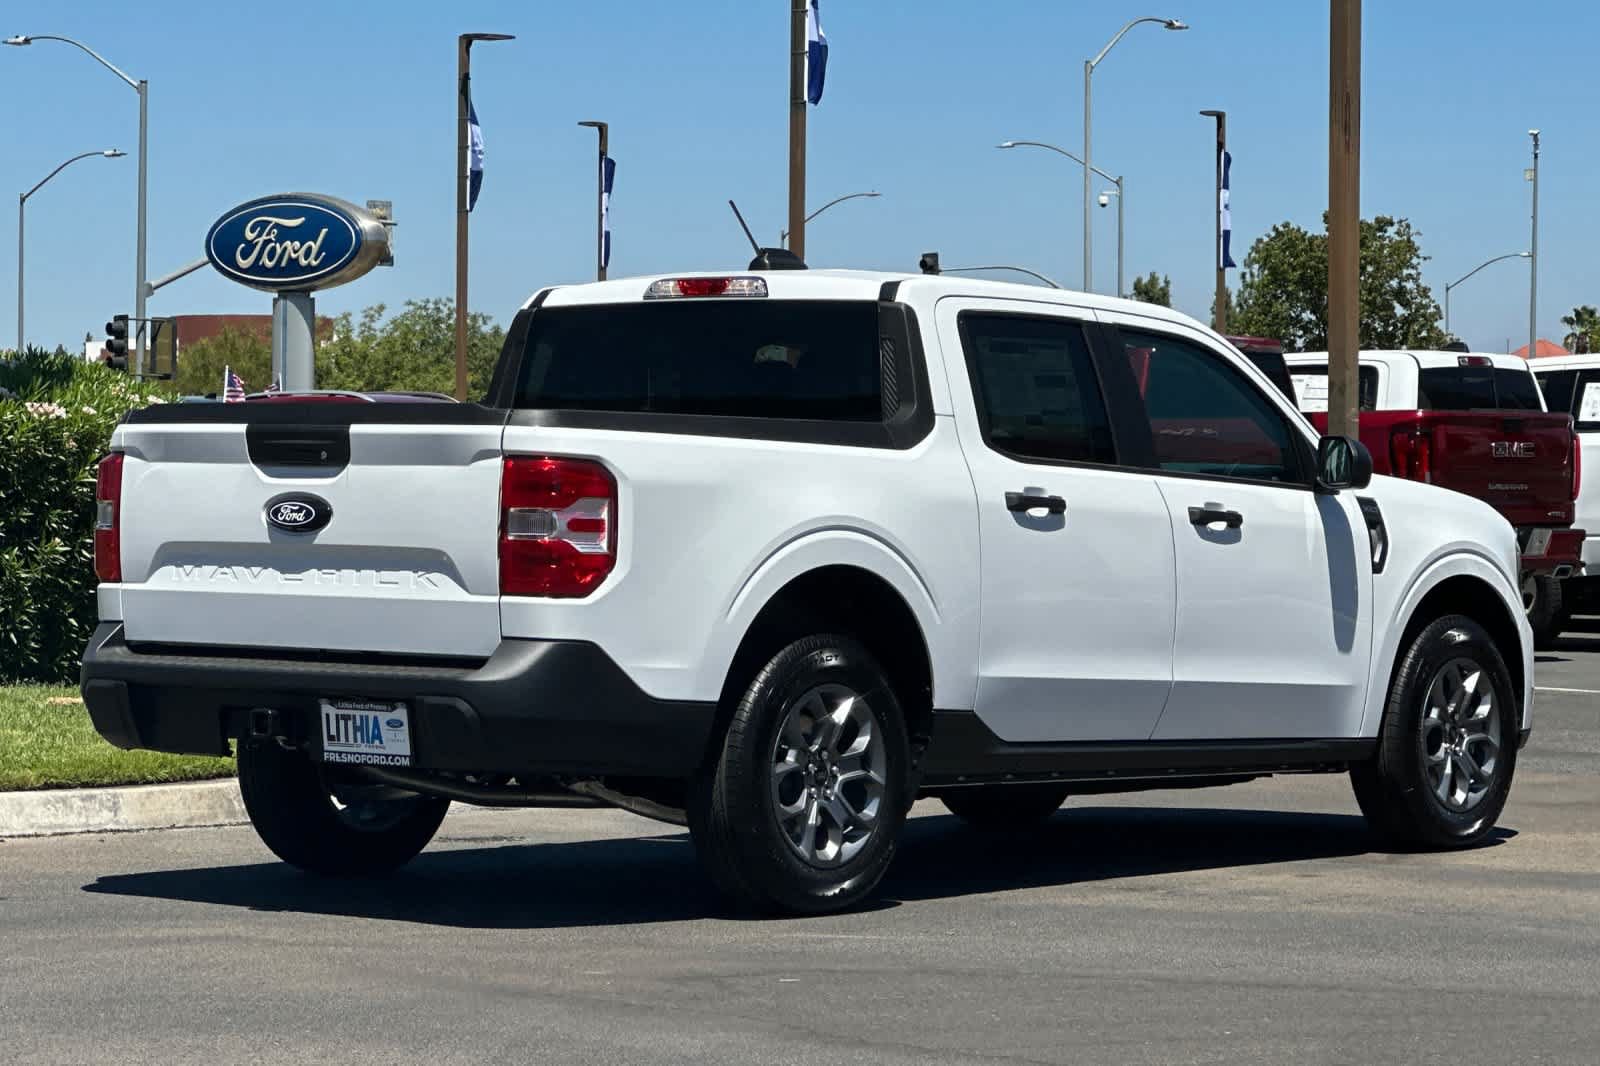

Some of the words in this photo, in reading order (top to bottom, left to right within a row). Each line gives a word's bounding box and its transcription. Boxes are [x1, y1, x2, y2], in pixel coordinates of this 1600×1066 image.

[235, 216, 329, 269] Ford
[1491, 441, 1536, 458] GMC
[278, 504, 306, 521] Ford
[325, 712, 384, 745] LITHIA
[324, 751, 410, 766] FRESNOFORD.COM
